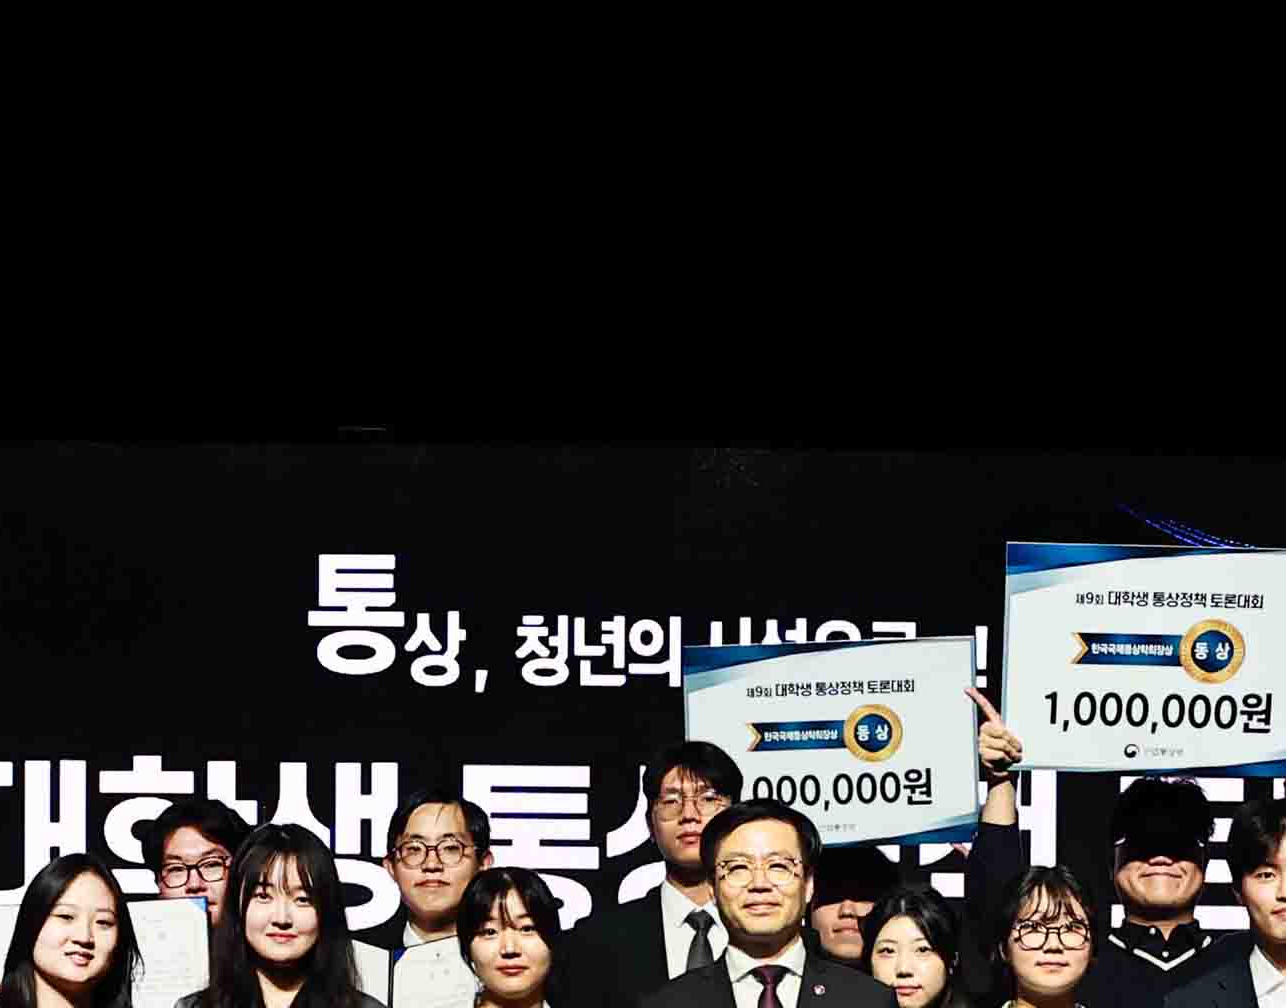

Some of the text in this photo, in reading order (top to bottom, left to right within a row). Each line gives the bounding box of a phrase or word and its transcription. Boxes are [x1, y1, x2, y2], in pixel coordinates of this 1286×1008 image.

[1076, 592, 1264, 609] 제9회 대학생 통상정책 토론대회
[308, 553, 488, 693] 통상,
[514, 614, 683, 690] 청년의
[747, 679, 915, 698] 제9회 대학생 통상정책 토론대회
[1044, 691, 1273, 734] 1,000,000원
